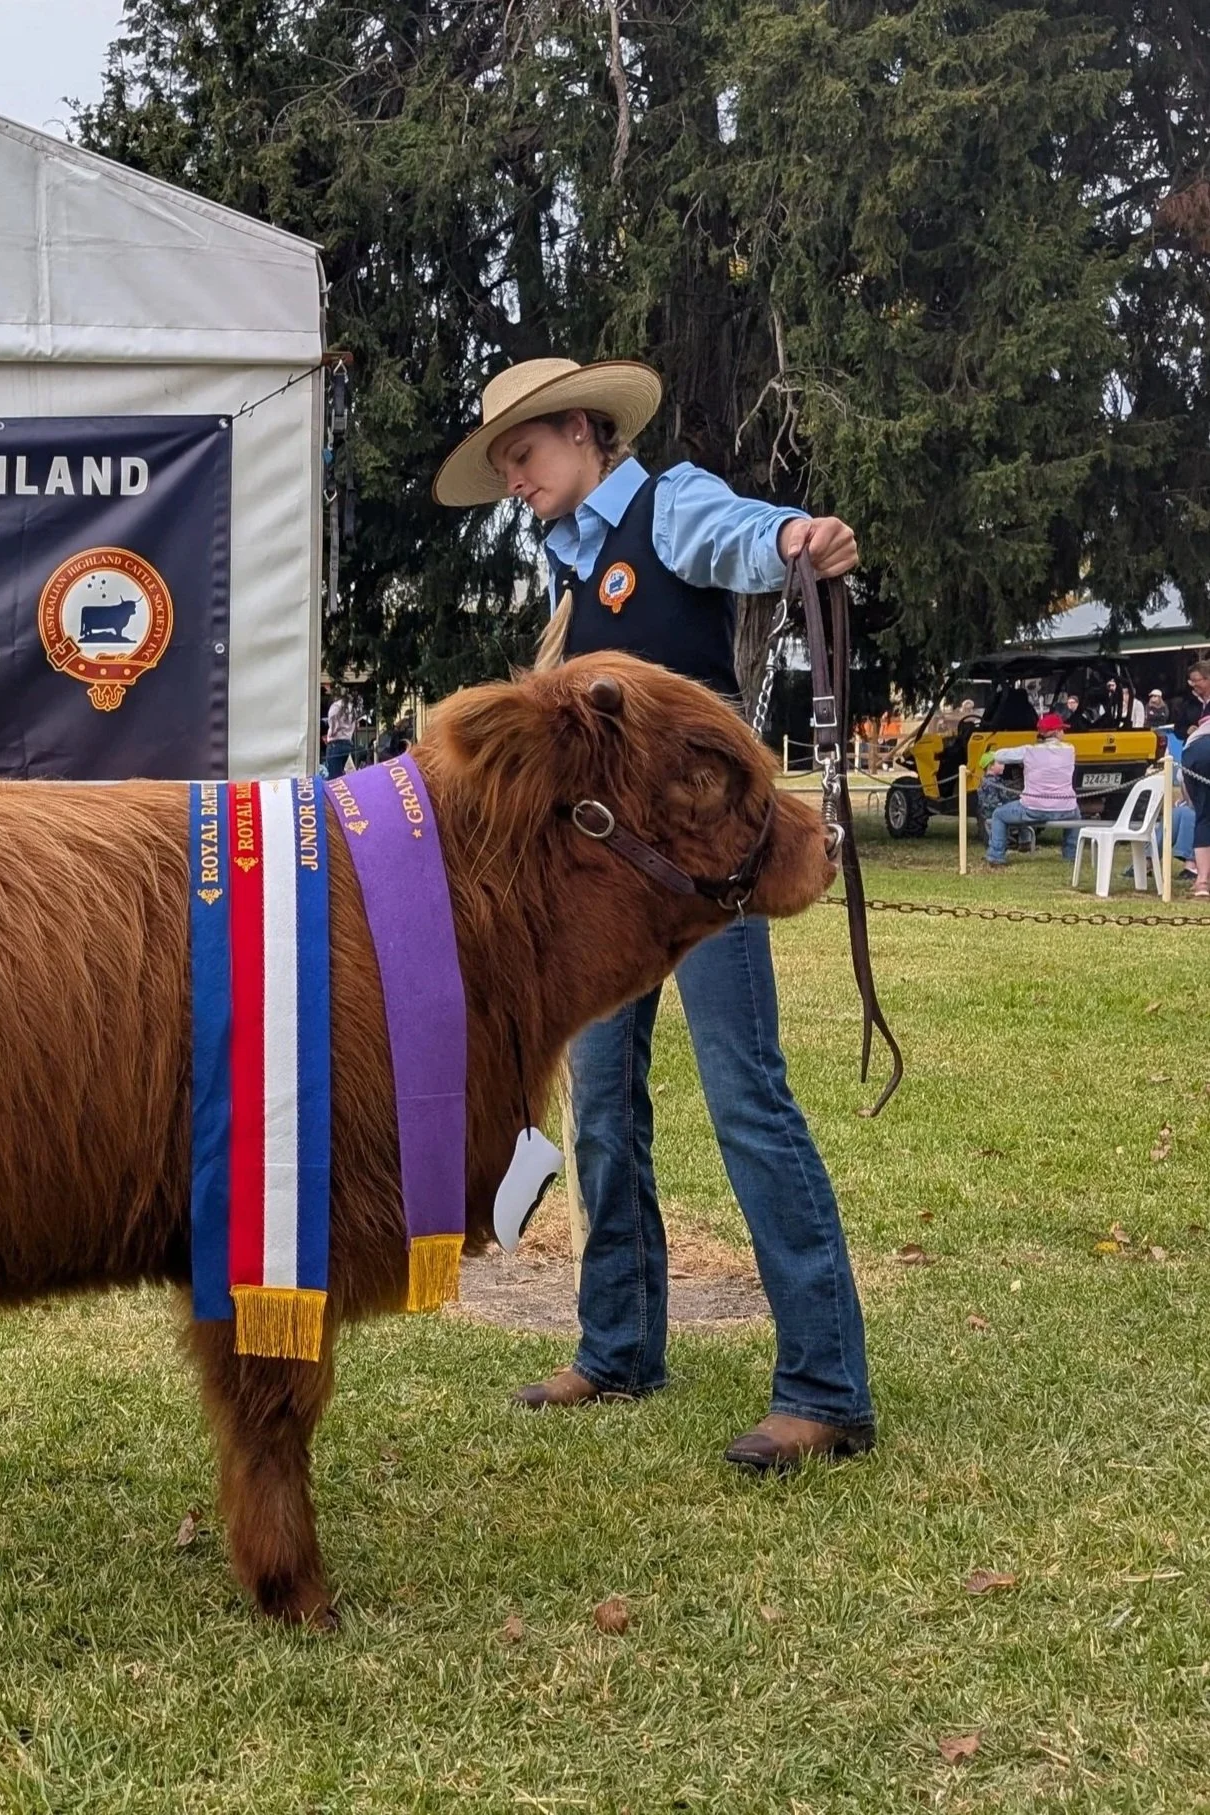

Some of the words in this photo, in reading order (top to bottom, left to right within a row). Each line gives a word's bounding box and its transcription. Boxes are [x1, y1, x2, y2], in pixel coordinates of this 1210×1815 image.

[67, 555, 122, 577] HIGHLAND
[125, 560, 157, 593] CATTLE
[45, 575, 68, 642] AUSTRALIAN
[152, 592, 165, 642] SOCIETY
[141, 642, 157, 661] INC
[390, 766, 423, 823] GRAND
[236, 801, 255, 851] ROYAL
[298, 804, 319, 871] JUNIOR
[201, 820, 219, 883] ROYAL
